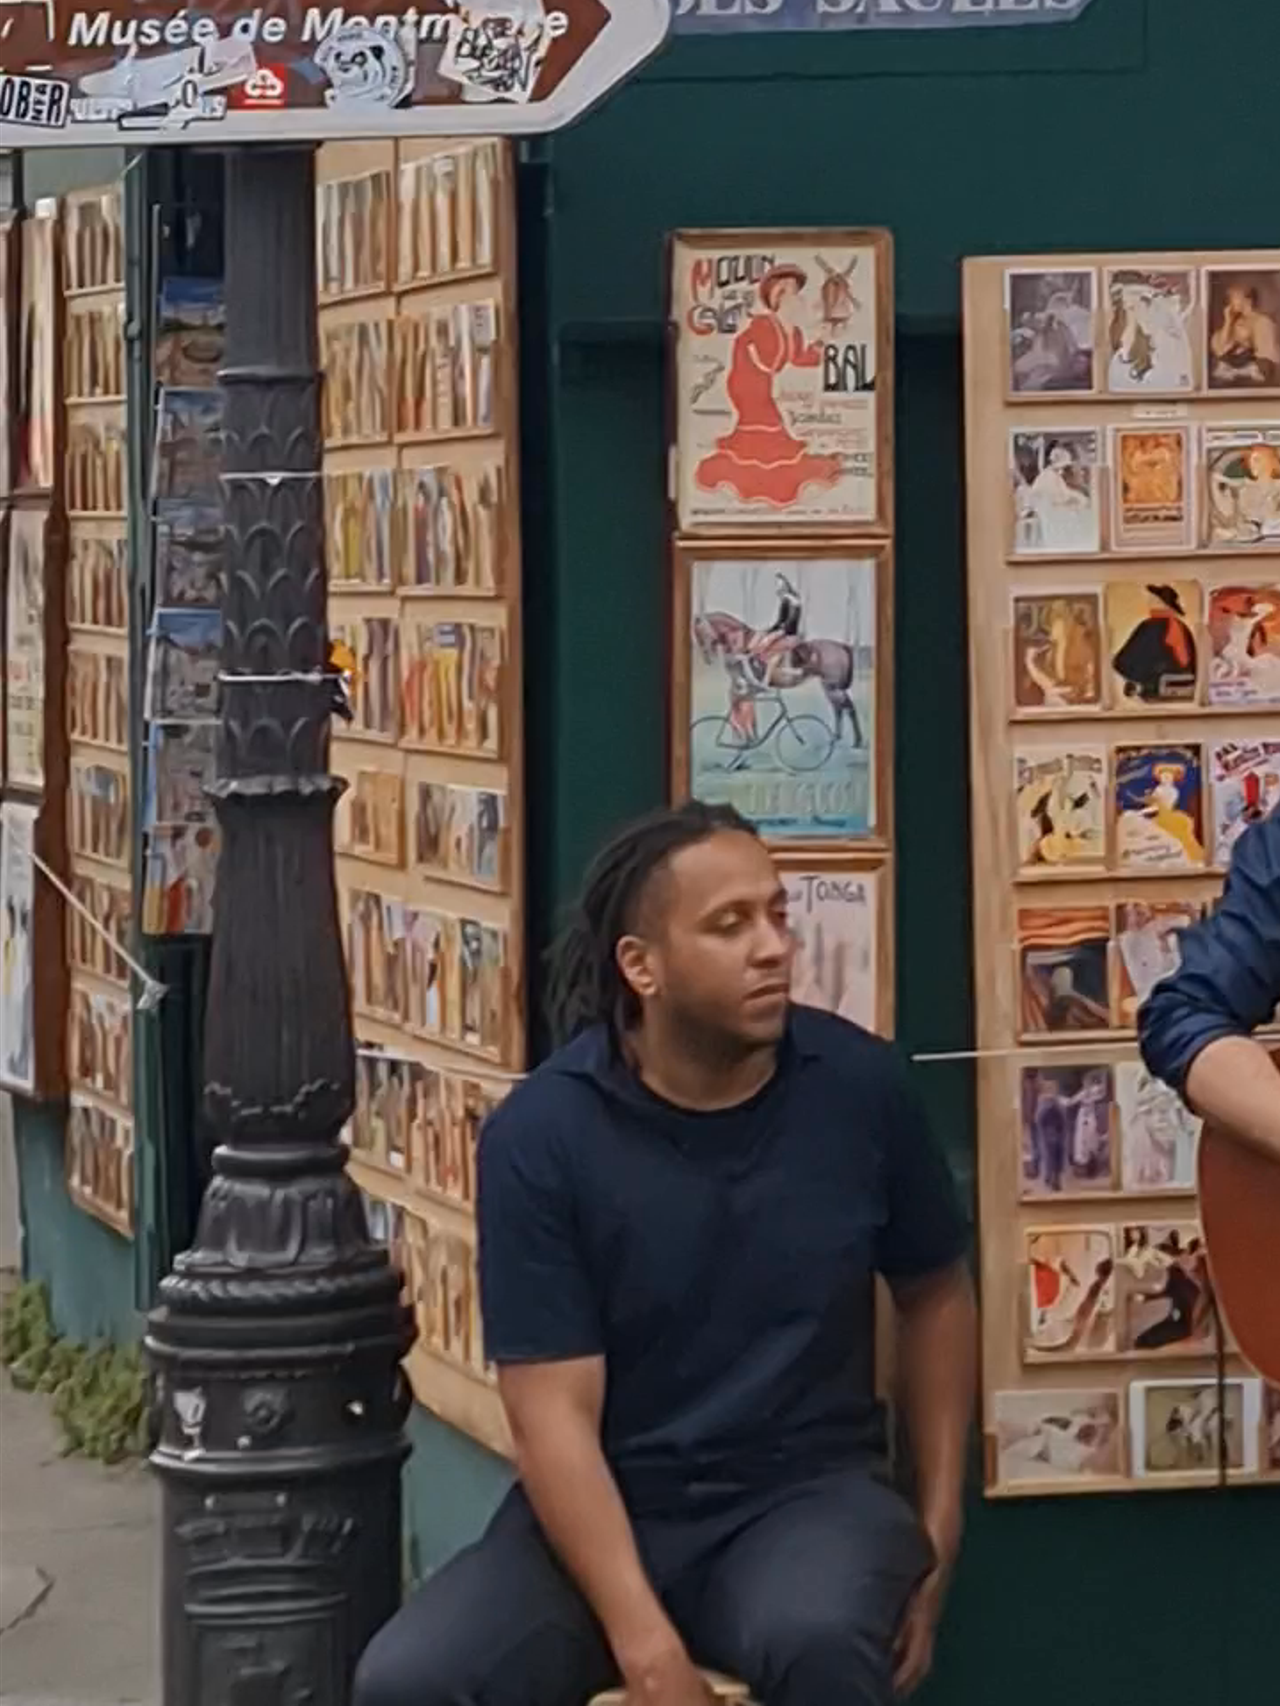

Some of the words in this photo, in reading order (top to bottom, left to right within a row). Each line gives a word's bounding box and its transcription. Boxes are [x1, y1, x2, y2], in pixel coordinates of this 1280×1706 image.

[67, 8, 220, 48] Musée
[231, 8, 288, 42] de
[823, 343, 876, 392] BAL
